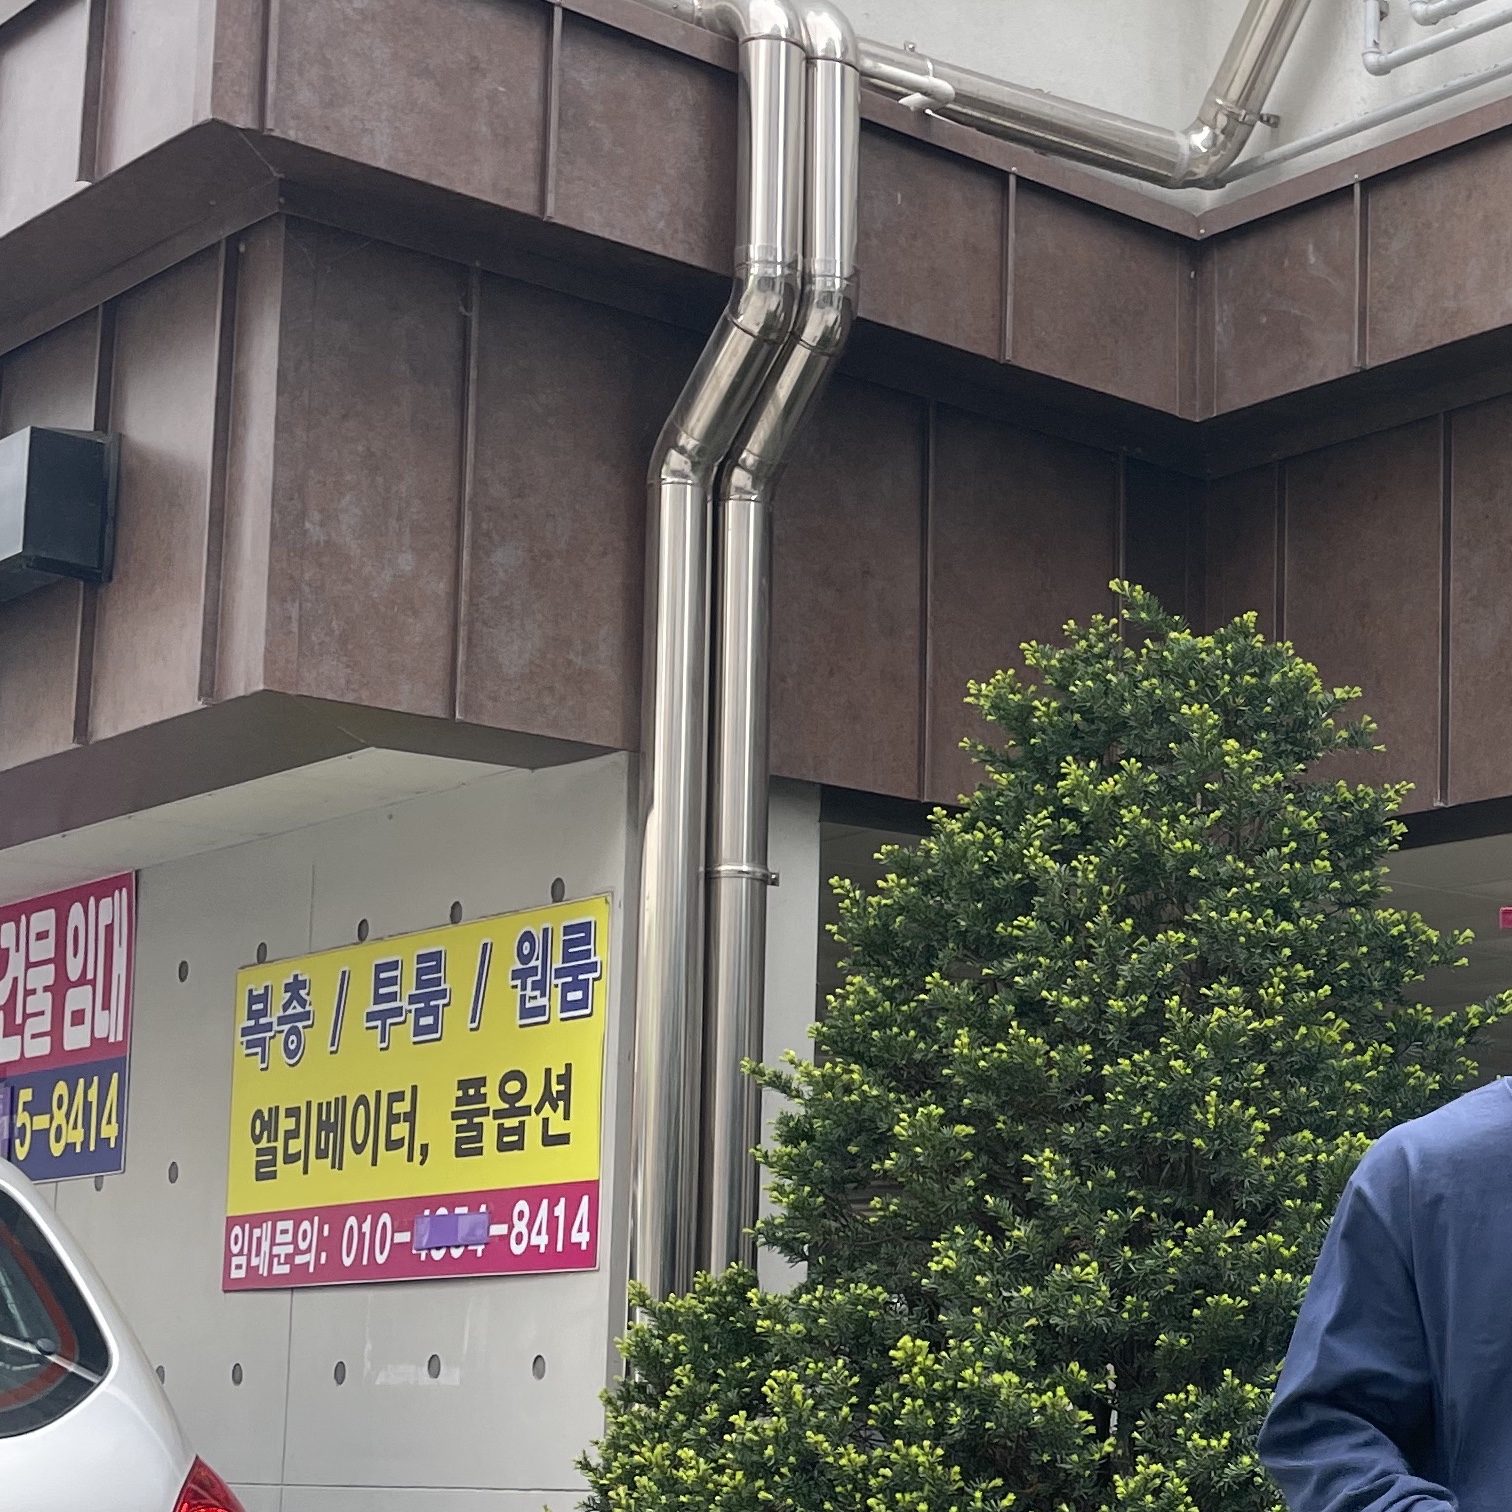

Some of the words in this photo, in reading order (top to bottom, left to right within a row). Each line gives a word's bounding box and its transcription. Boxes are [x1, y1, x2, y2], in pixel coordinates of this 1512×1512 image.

[62, 887, 128, 1052] 임대
[239, 972, 314, 1071] 복층
[364, 948, 452, 1052] 투룸
[510, 919, 602, 1028] 원룸
[250, 1084, 429, 1181] 엘리베이터,
[450, 1062, 573, 1159] 풀옵션
[229, 1215, 329, 1279] 임대문의:
[341, 1194, 590, 1268] 010--8414
